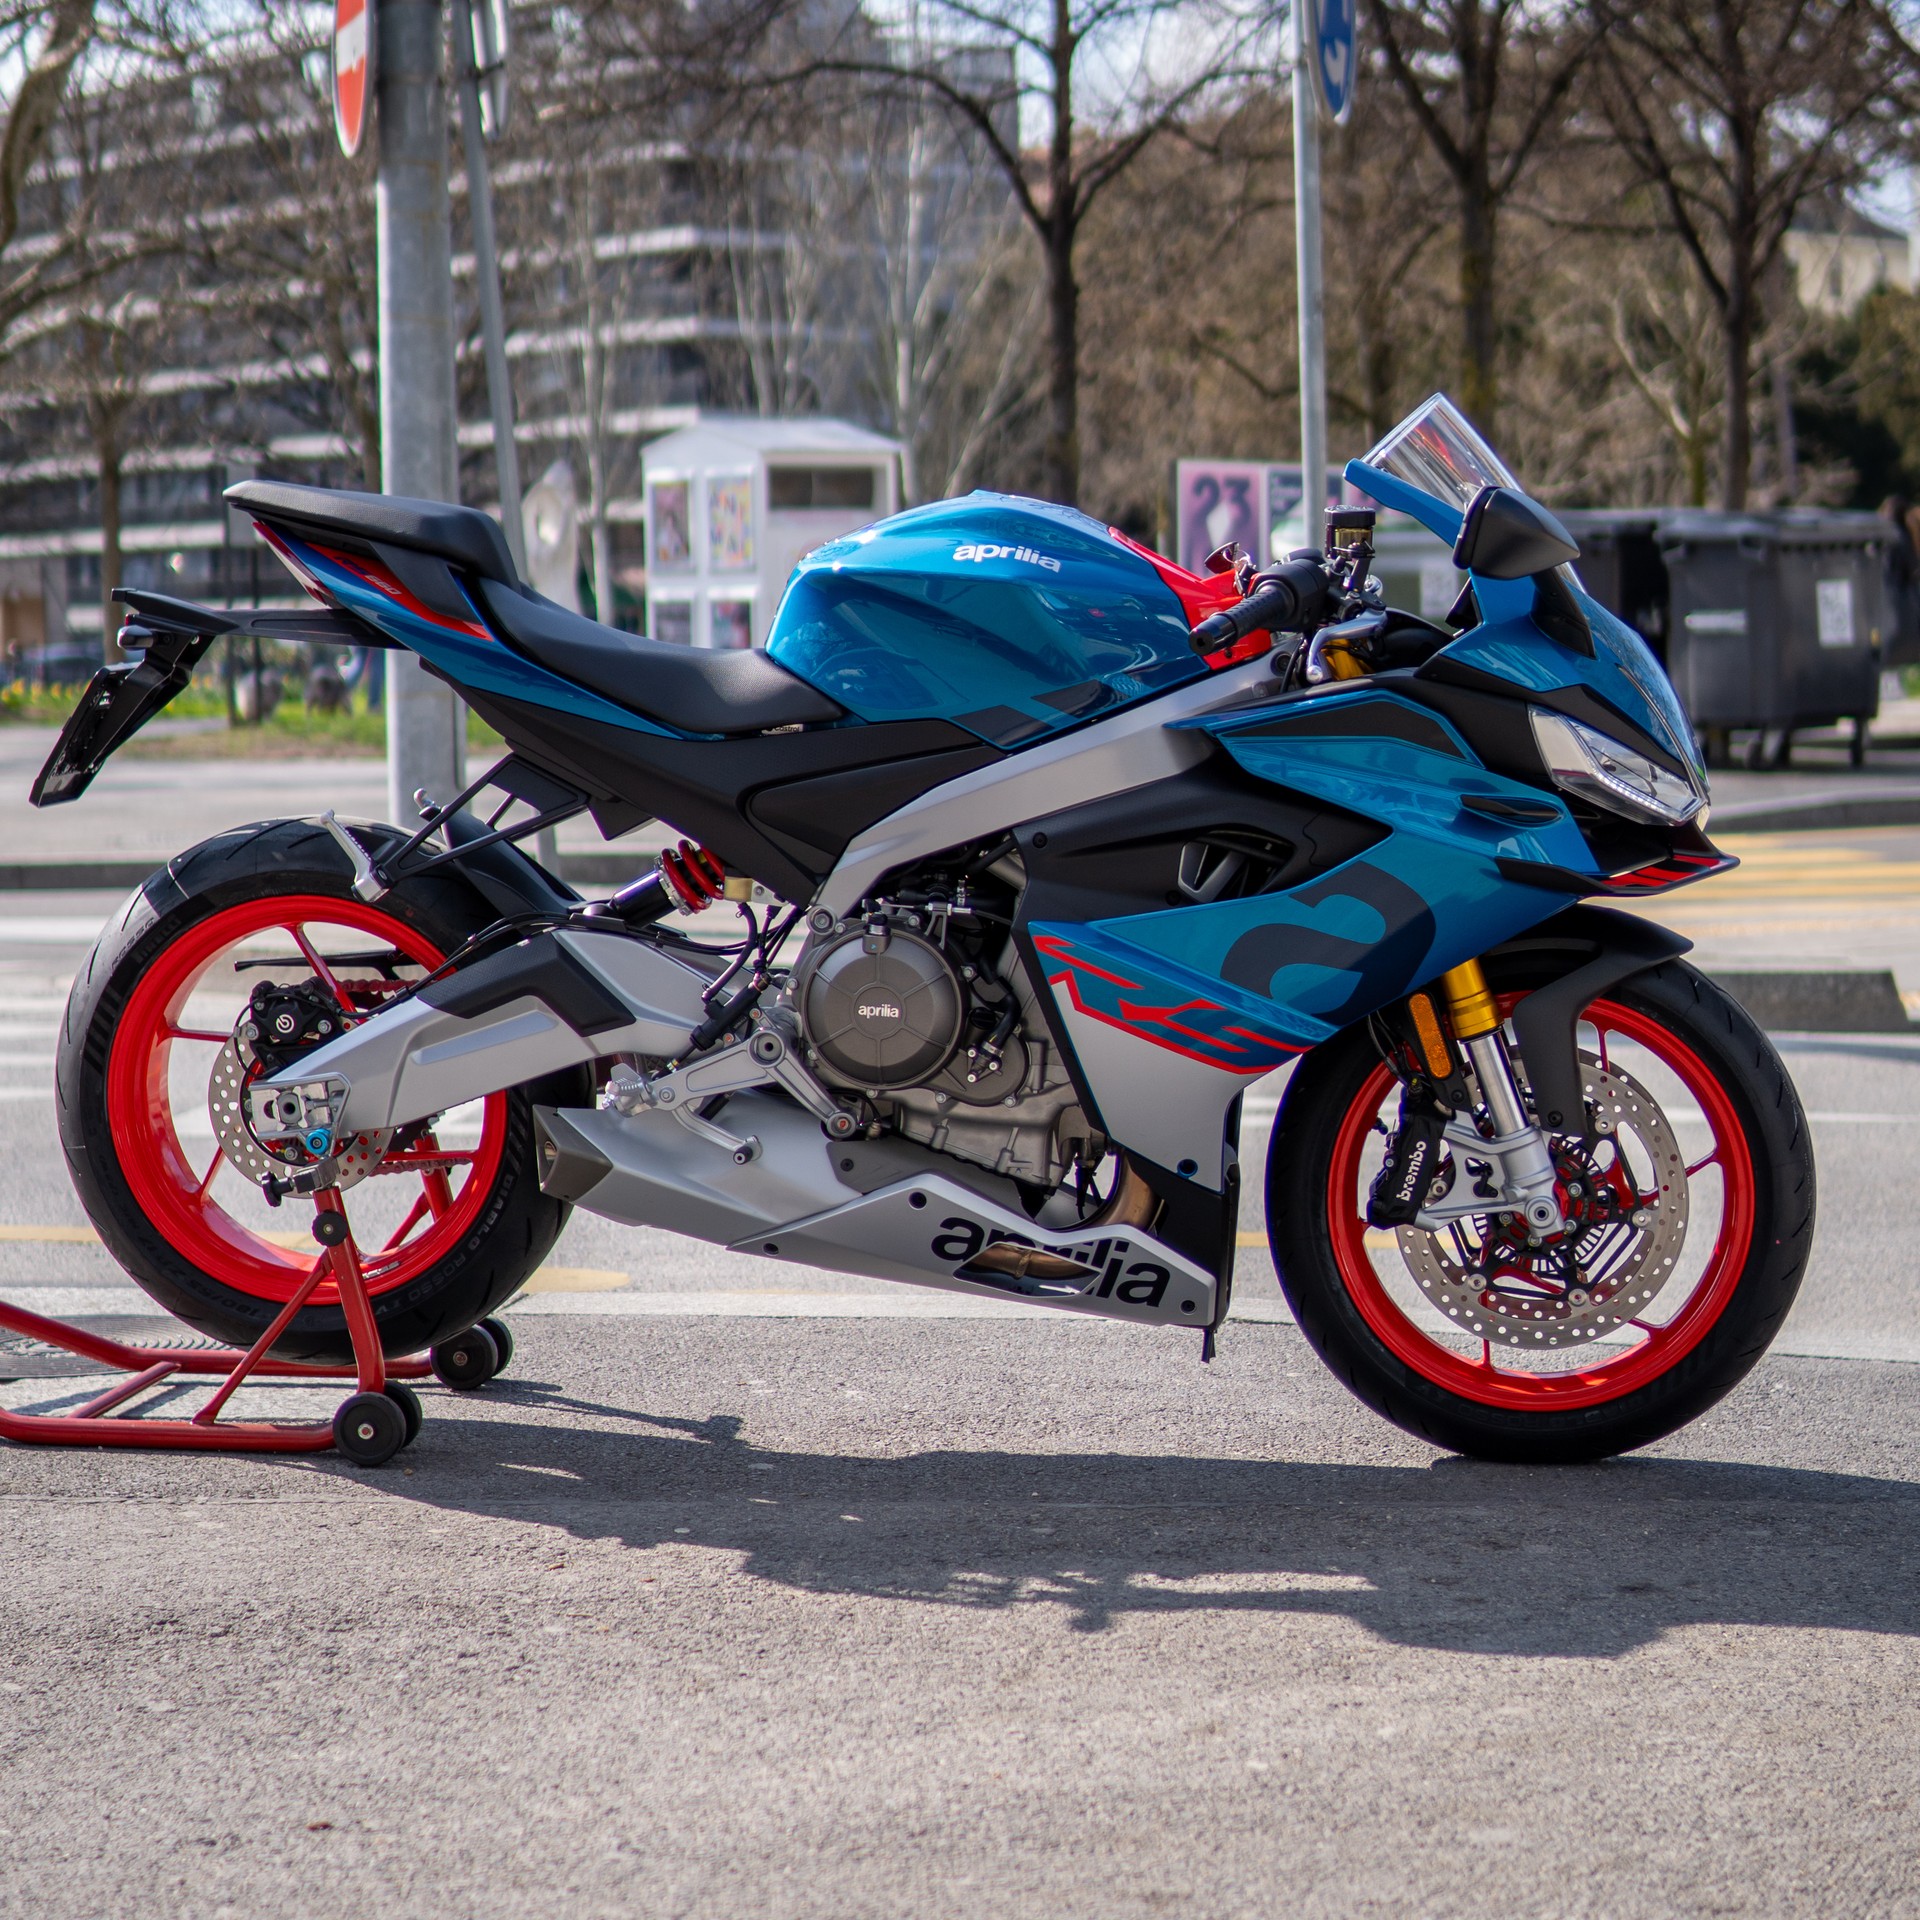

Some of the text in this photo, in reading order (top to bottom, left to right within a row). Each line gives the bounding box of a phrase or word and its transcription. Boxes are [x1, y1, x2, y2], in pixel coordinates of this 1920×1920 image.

[952, 544, 1061, 573] aprilia
[365, 574, 402, 595] 660
[858, 1004, 899, 1019] aprilia
[1396, 1141, 1427, 1201] brembo
[466, 1174, 515, 1251] DIABLO
[407, 1251, 467, 1301] ROSSO
